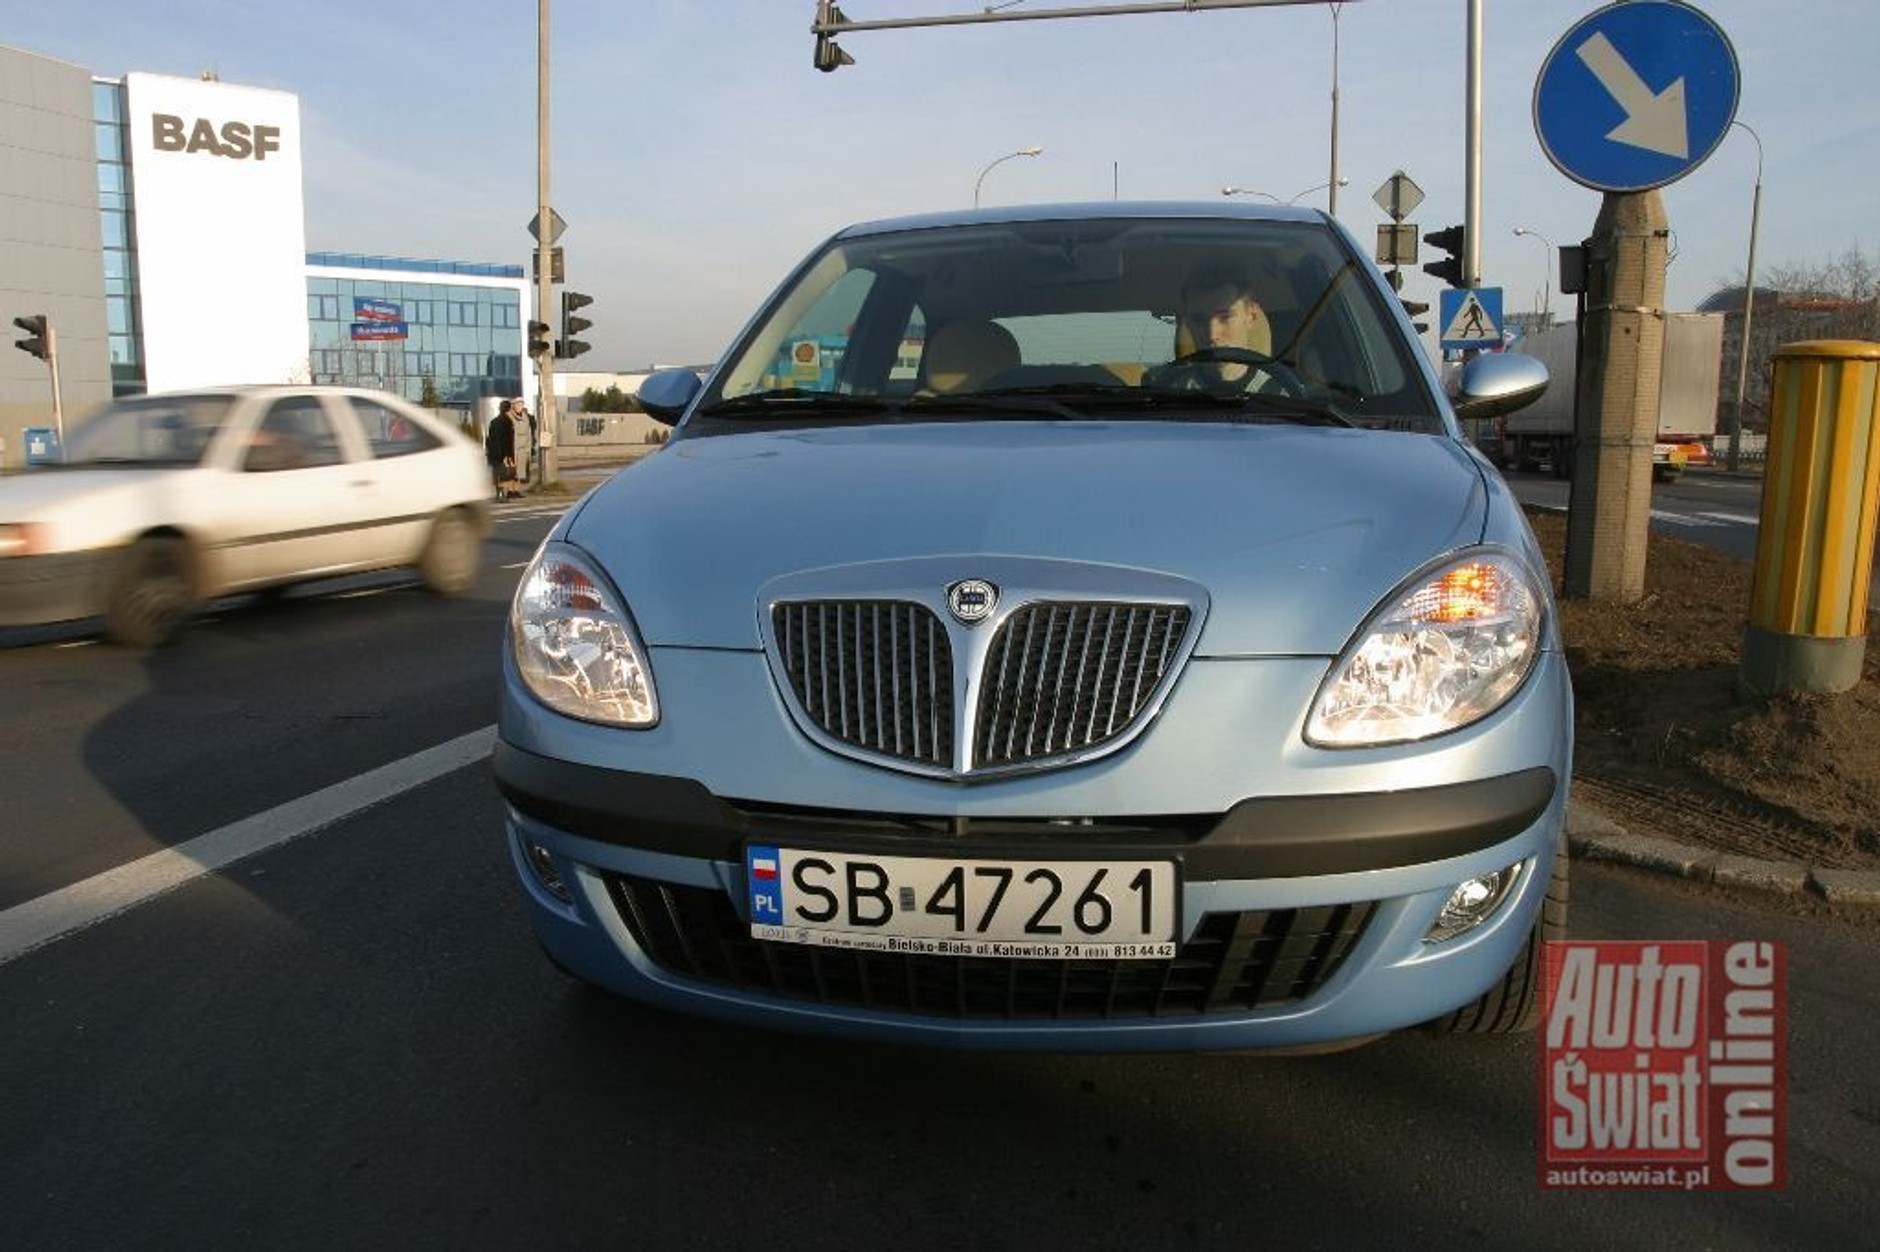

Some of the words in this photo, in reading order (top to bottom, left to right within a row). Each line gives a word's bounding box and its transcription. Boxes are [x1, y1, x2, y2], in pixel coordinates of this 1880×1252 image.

[152, 113, 280, 161] BASF
[754, 893, 779, 913] PL
[792, 858, 894, 926] SB
[925, 866, 1152, 935] 47261
[1064, 945, 1080, 956] 24
[1114, 945, 1136, 956] 813
[1139, 945, 1154, 956] 44
[1157, 945, 1172, 956] 42
